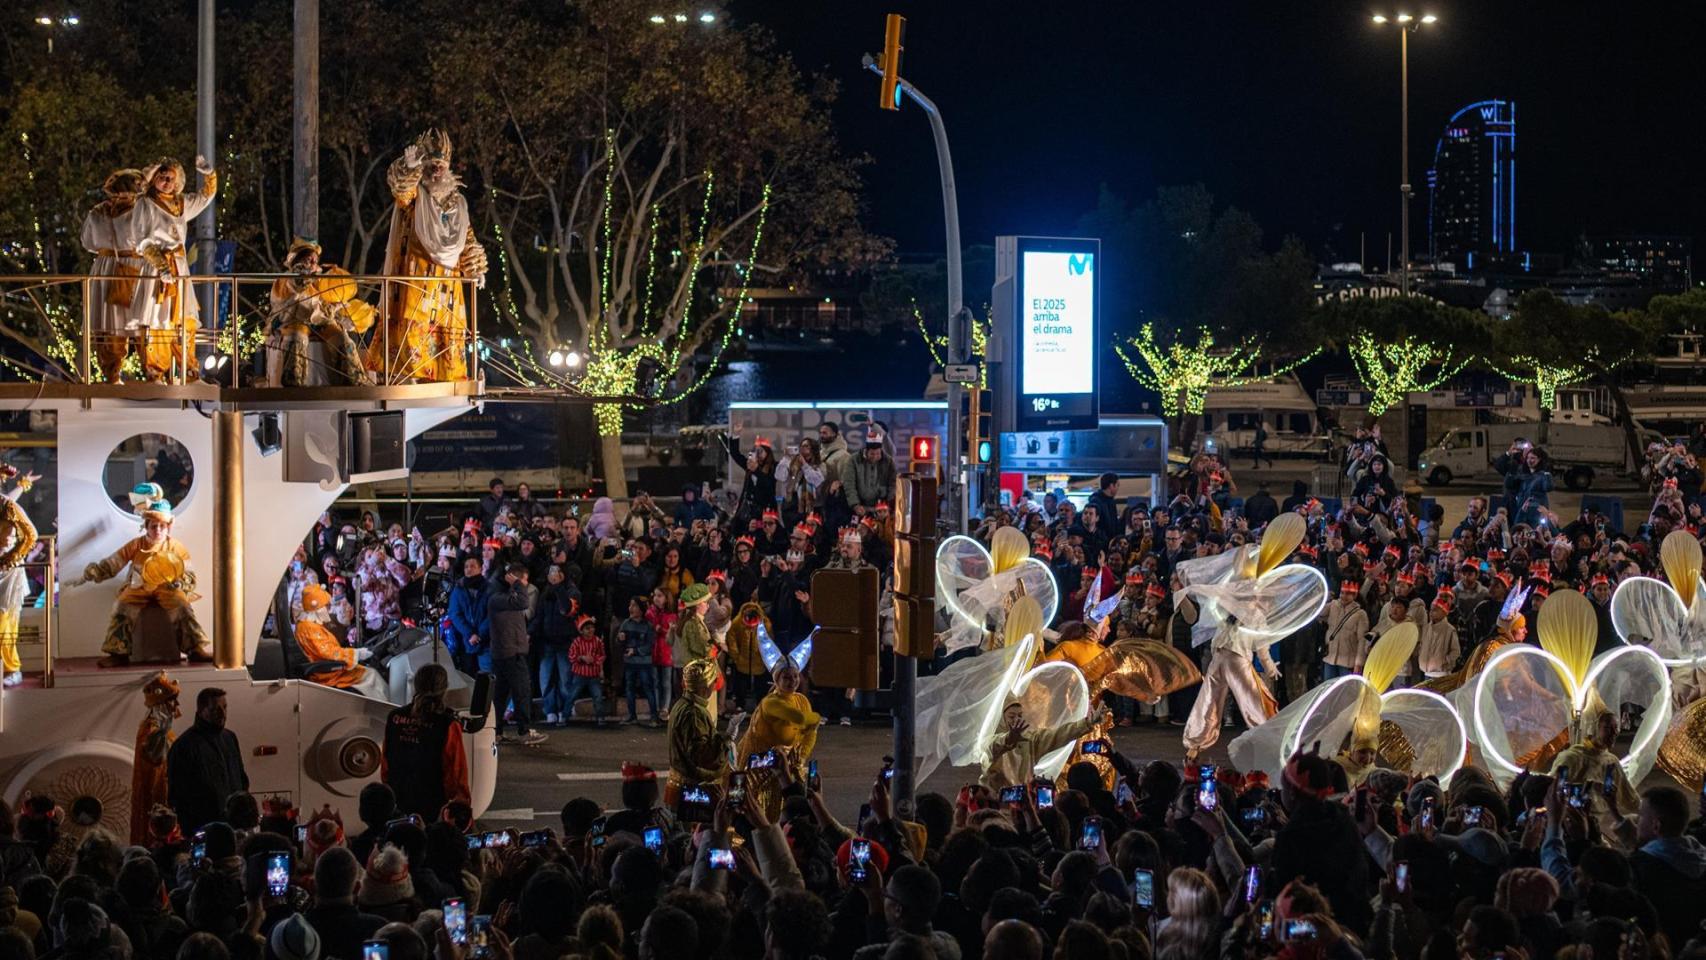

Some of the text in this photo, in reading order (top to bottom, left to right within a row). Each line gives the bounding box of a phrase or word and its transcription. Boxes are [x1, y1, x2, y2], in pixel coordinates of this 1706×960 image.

[1480, 107, 1493, 119] W
[1033, 298, 1066, 310] El 2025
[1033, 323, 1073, 334] el drama
